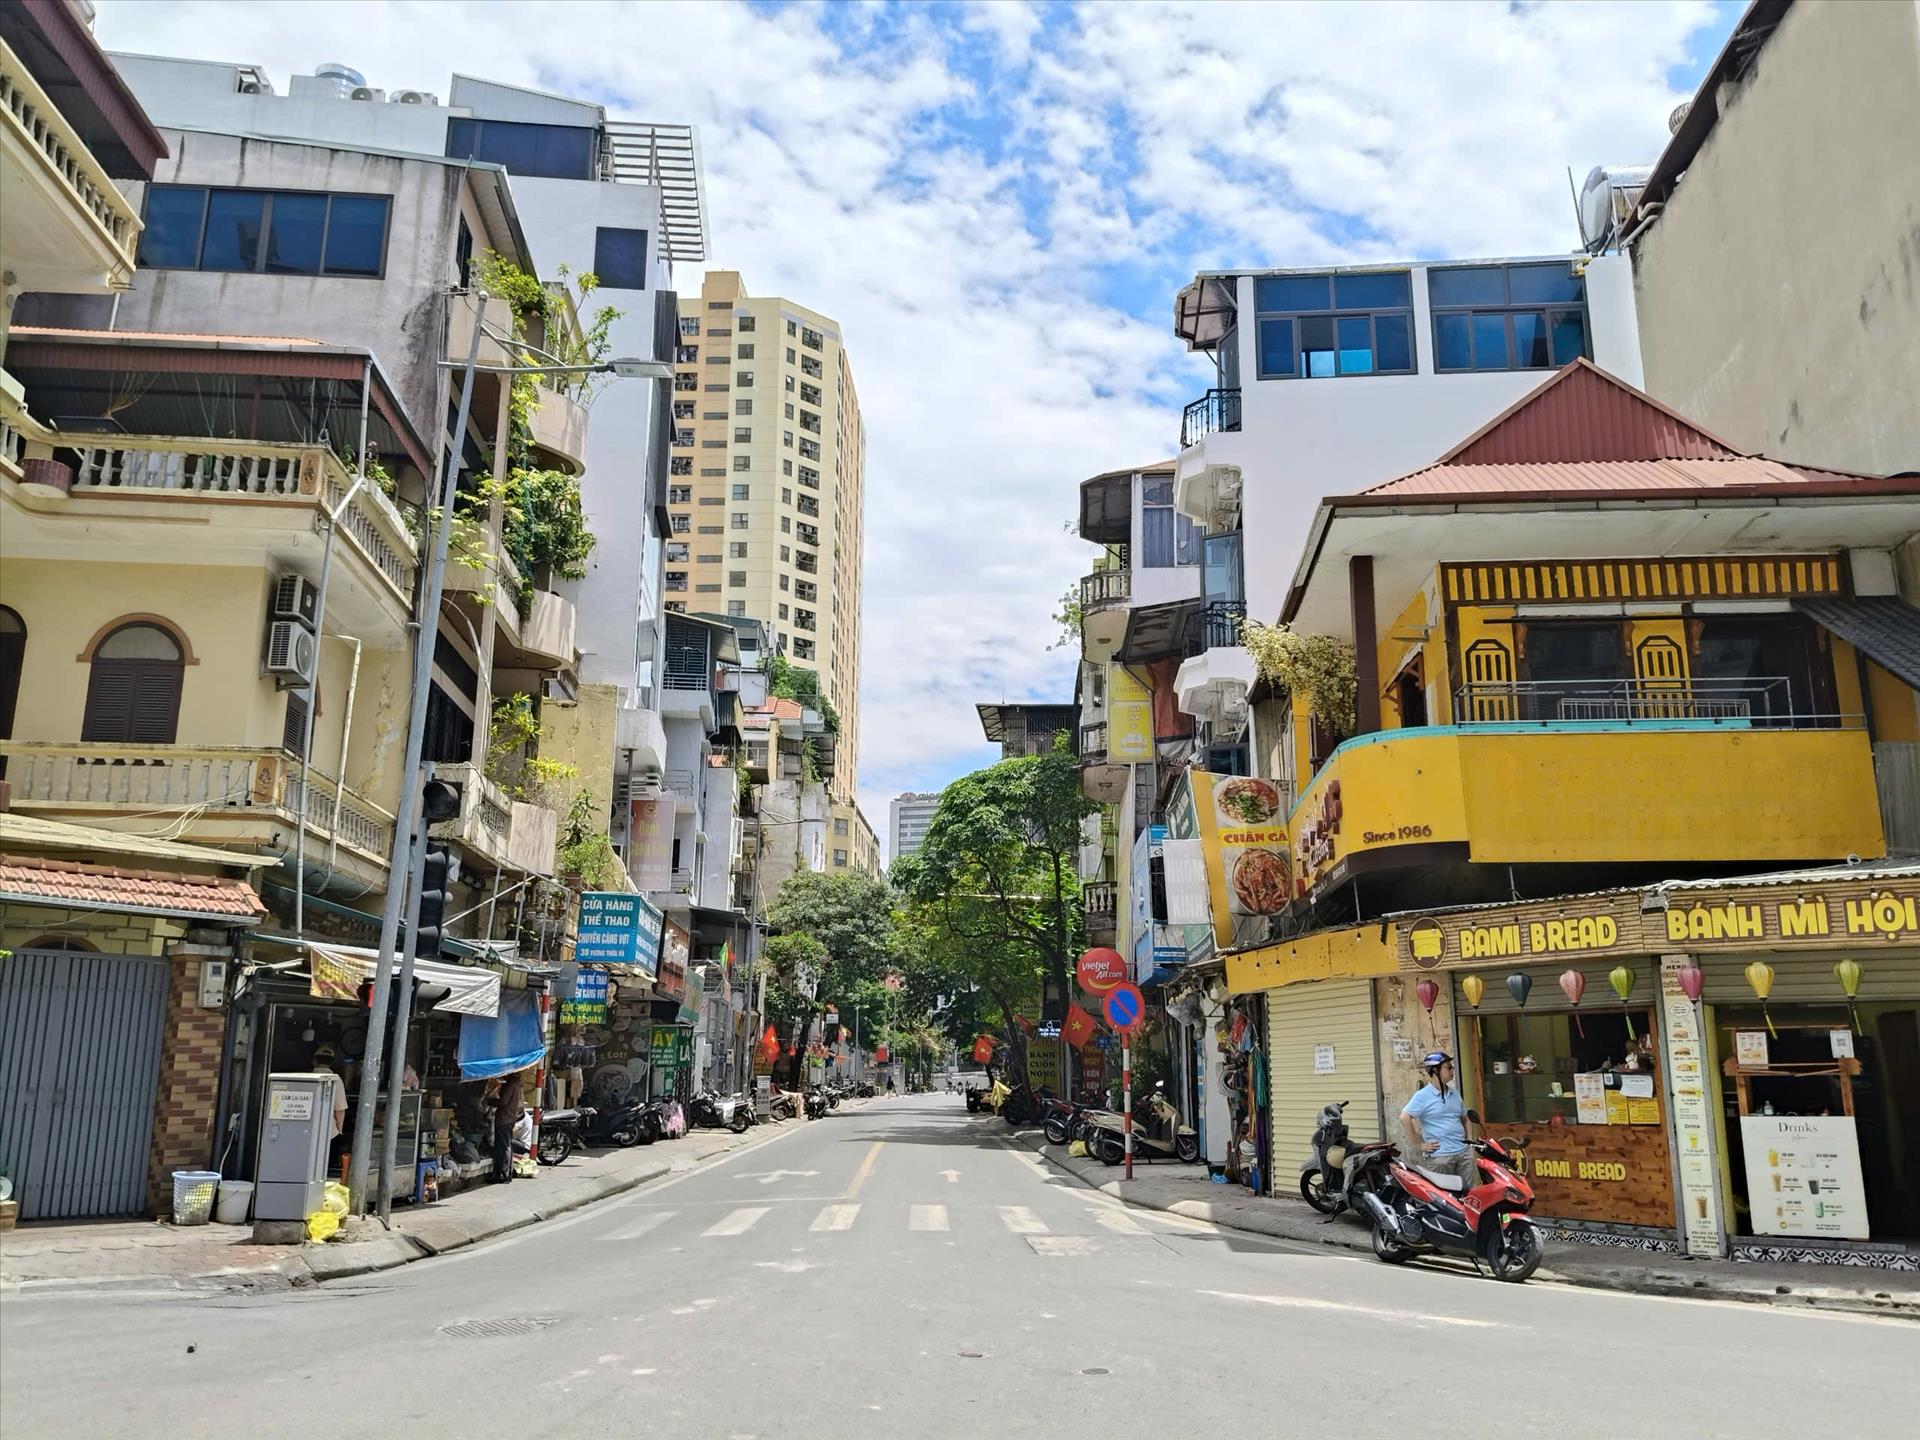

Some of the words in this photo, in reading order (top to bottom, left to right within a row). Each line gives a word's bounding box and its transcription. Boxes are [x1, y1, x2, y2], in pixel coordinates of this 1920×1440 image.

[1223, 830, 1265, 843] CHÂN
[1267, 830, 1288, 842] GÀ
[1363, 831, 1396, 844] Since
[1397, 825, 1432, 839] 1986
[582, 896, 603, 910] CỬA
[605, 897, 634, 911] HÀNG
[583, 911, 603, 926] THỂ
[604, 915, 630, 927] THAO
[1666, 902, 1764, 940] BÁNH
[1779, 894, 1830, 937] MÌ
[1846, 890, 1918, 940] HỘI
[1460, 924, 1522, 959] BAMI
[1529, 915, 1617, 953] BREAD
[1778, 1122, 1819, 1133] Drinks
[1534, 1159, 1571, 1178] BAMI
[1578, 1161, 1626, 1181] BREAD
